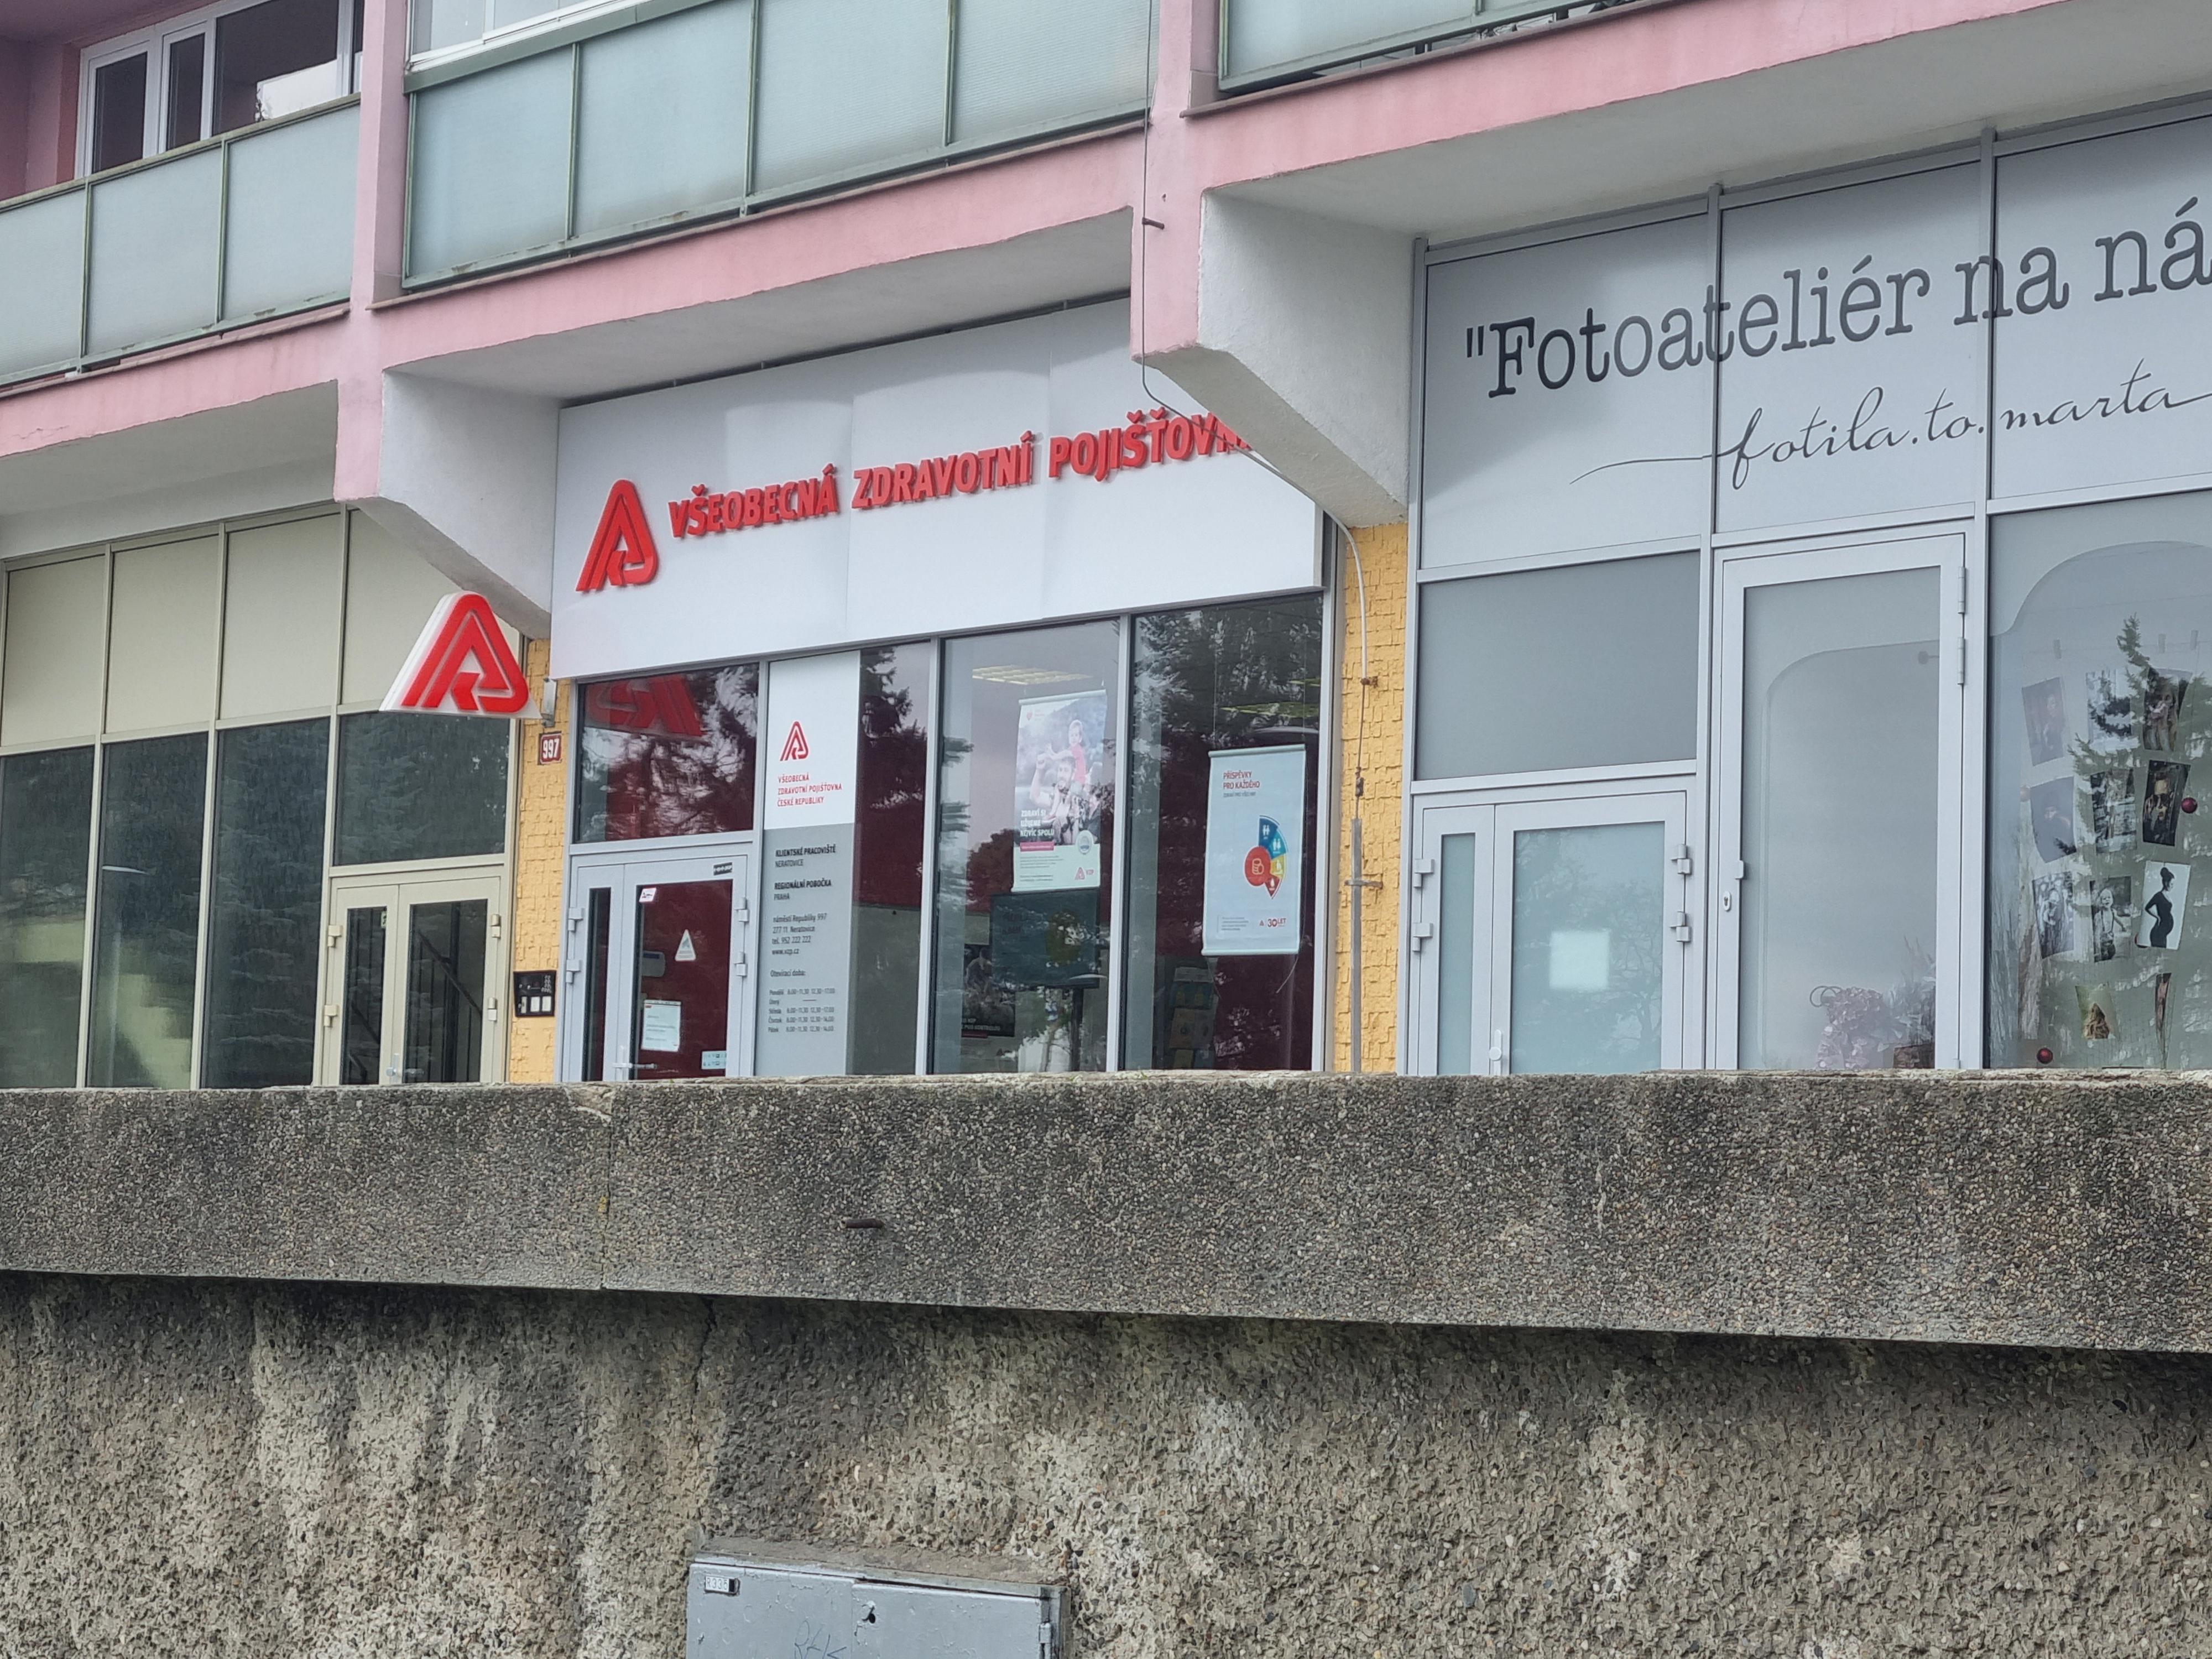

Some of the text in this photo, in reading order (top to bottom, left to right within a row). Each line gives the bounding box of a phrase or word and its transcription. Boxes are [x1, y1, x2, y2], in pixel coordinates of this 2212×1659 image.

[1954, 247, 2069, 325] na
[669, 463, 839, 538] VŠEOBECNÁ
[852, 431, 1034, 509] ZDRAVOTNÍ
[542, 738, 560, 759] 997
[778, 772, 809, 783] VŠEOBECNÁ
[1223, 770, 1252, 779] PŘÍSPĚVKY
[778, 783, 842, 795] ZDRAVOTNÍ POJIŠŤOVNA
[1235, 779, 1260, 789] KAŽDÉHO
[778, 796, 825, 807] ČESKÉ REPUBLIKY
[1037, 828, 1055, 837] SPOLU
[775, 844, 836, 857] KLIENTSKÉ PRACOVIŠTĚ
[775, 859, 804, 868] NERATOVICE
[774, 878, 832, 890] REGIONÁLNÍ POBOČKA
[817, 912, 827, 921] 997
[1267, 919, 1277, 927] 30
[706, 1577, 728, 1590] R335
